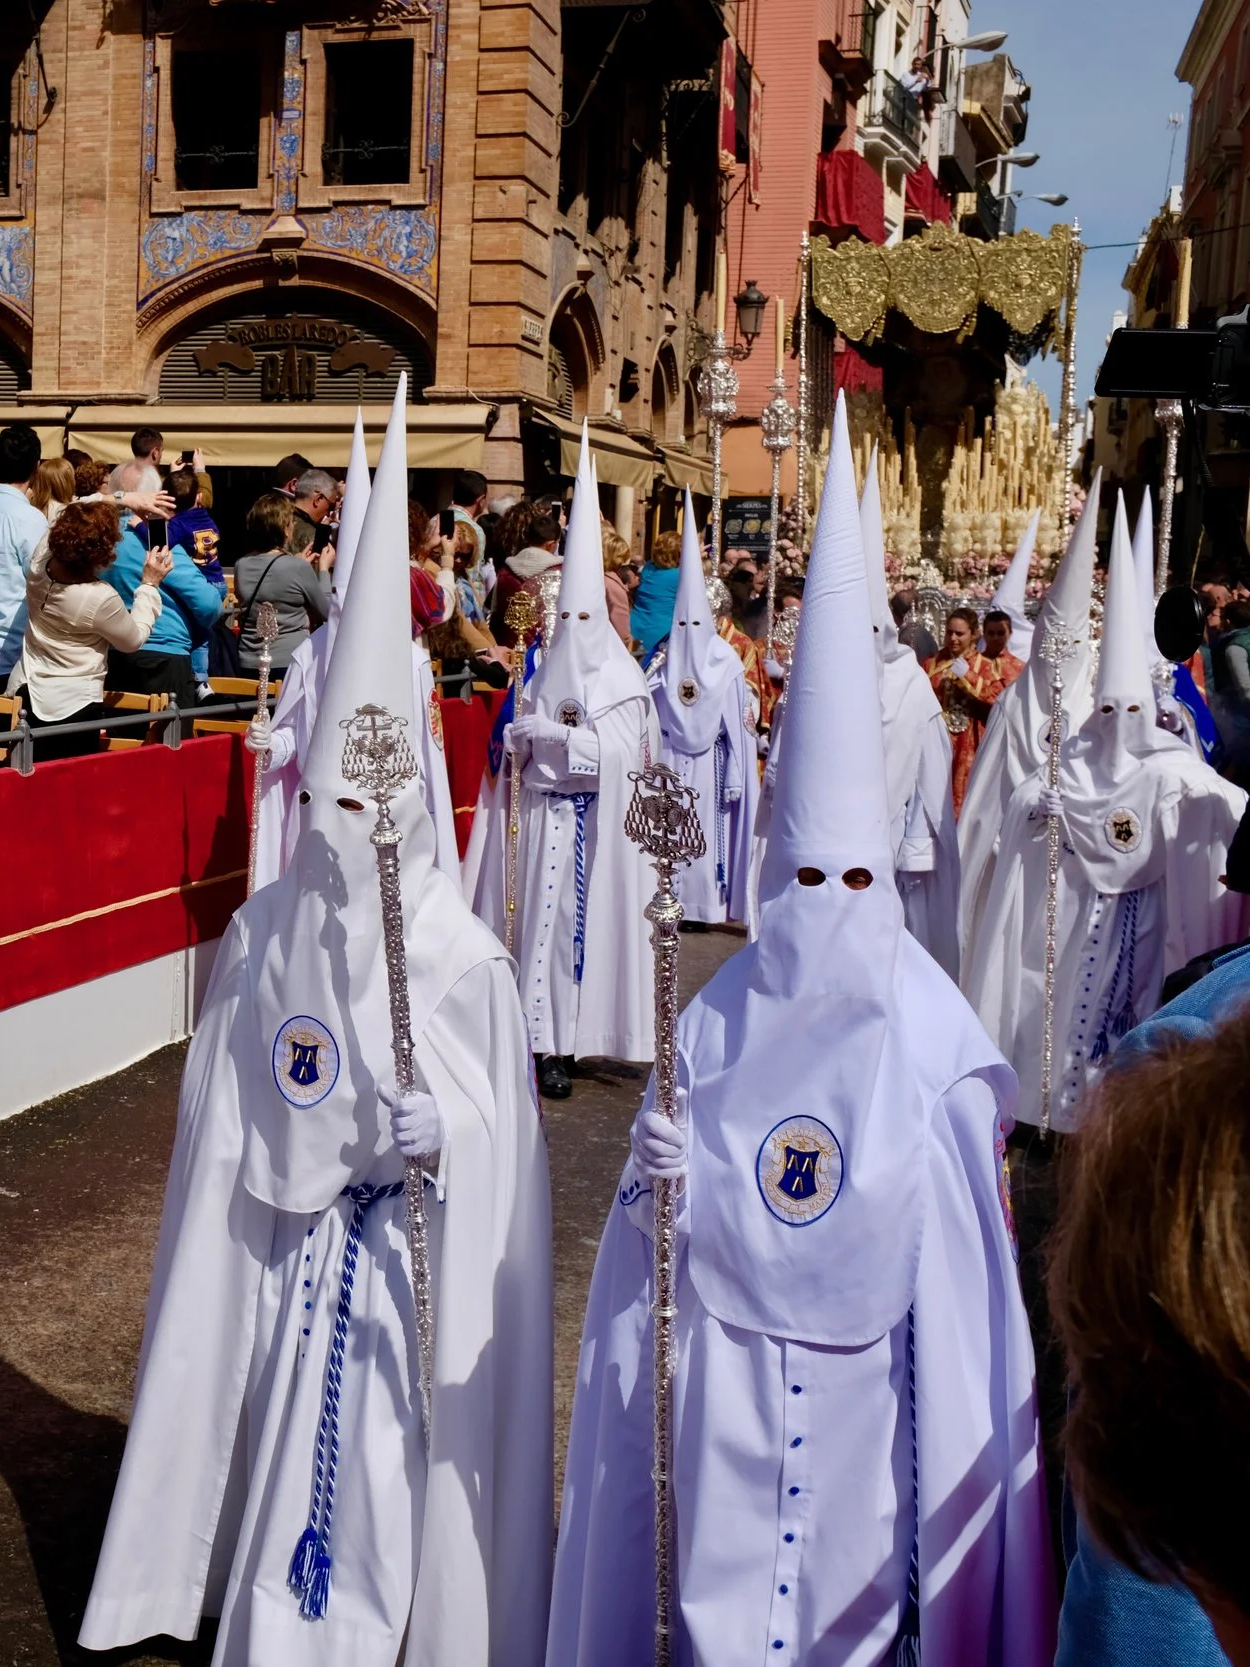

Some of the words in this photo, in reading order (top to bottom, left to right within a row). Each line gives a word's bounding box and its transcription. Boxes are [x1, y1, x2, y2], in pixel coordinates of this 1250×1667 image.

[238, 323, 291, 346] ROBLES
[291, 323, 348, 346] LAREDO
[262, 344, 317, 398] BAR
